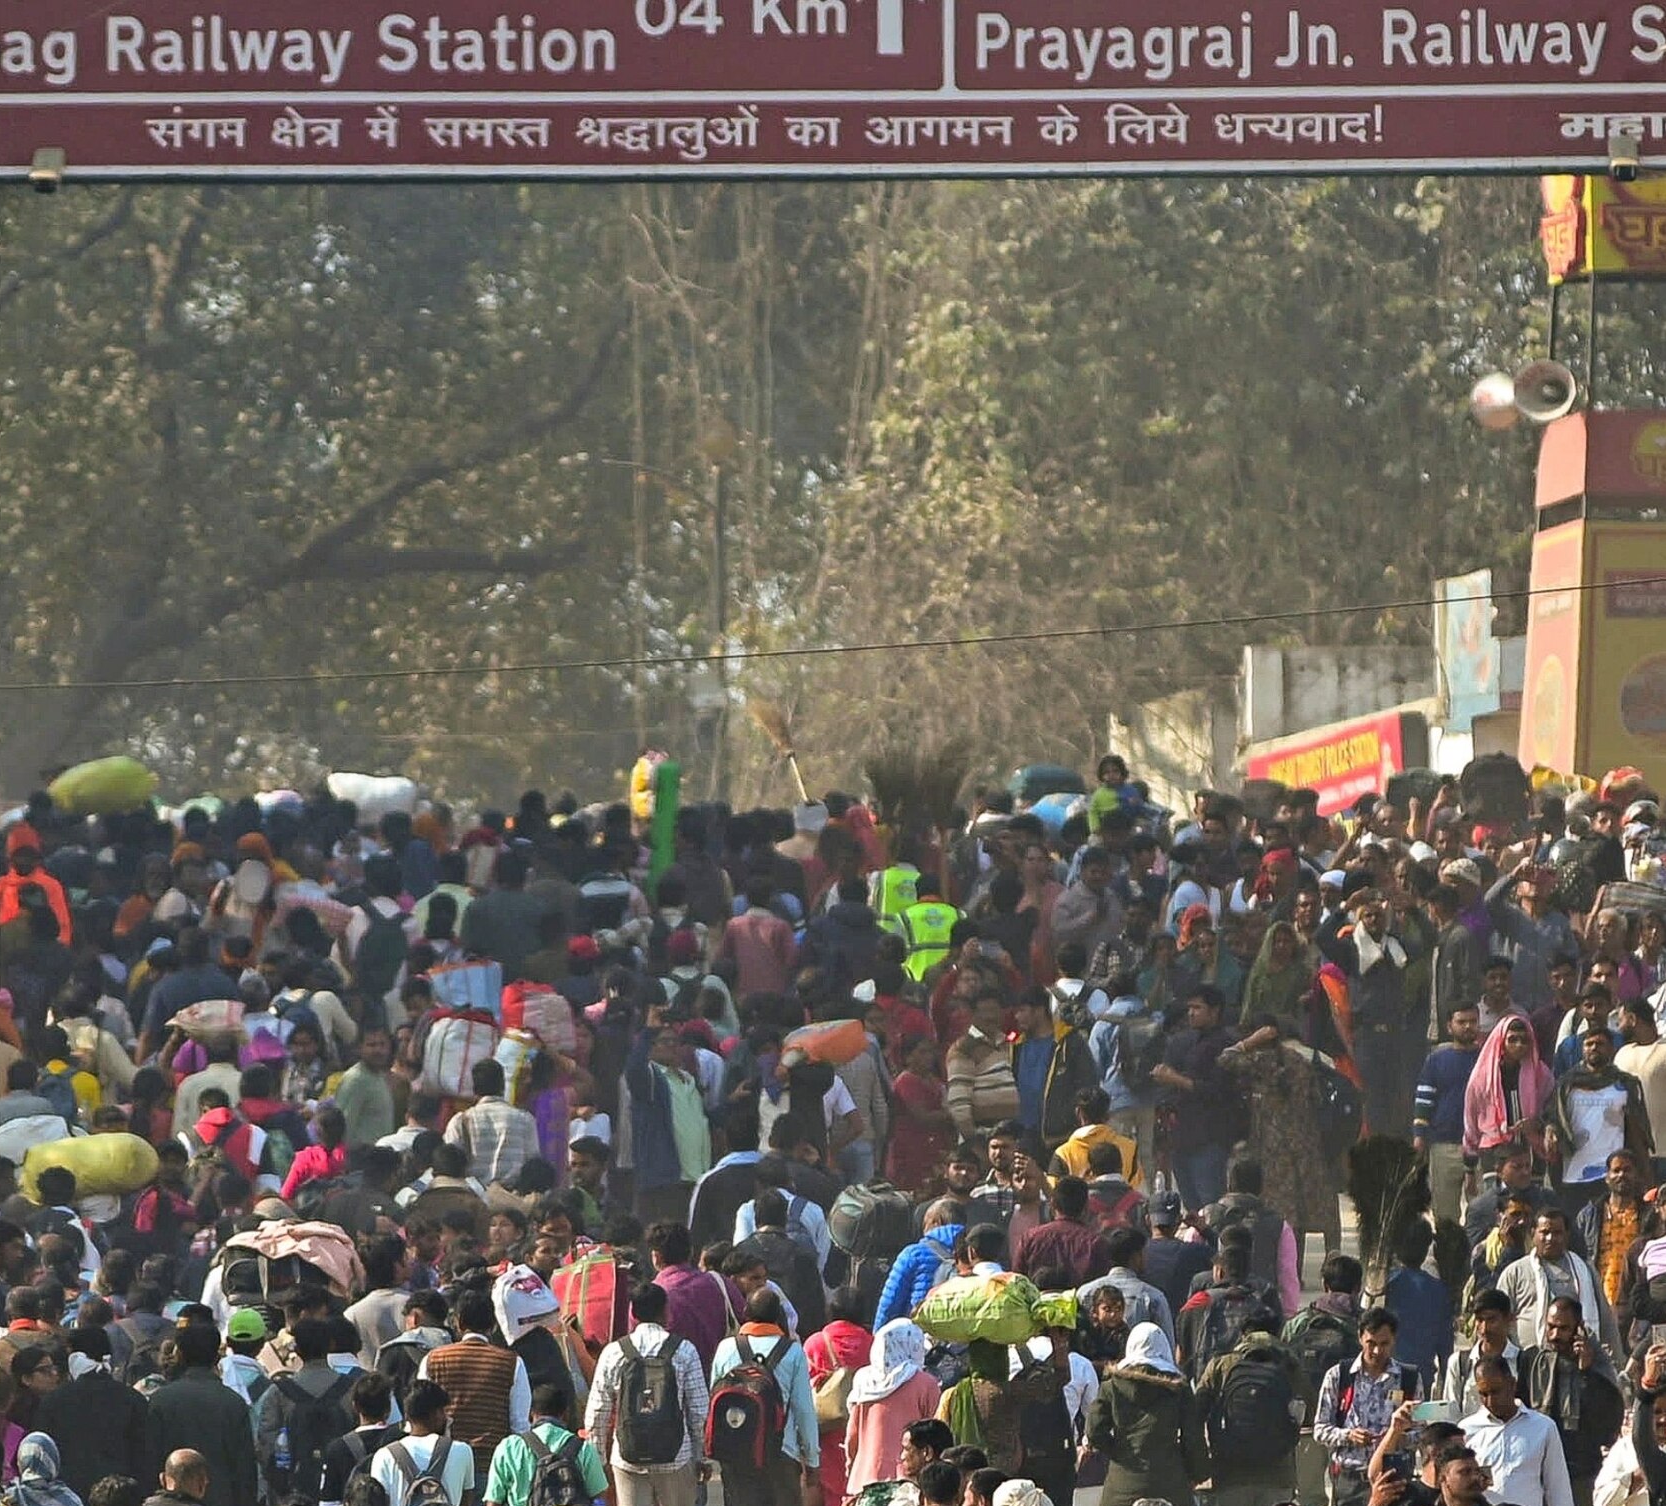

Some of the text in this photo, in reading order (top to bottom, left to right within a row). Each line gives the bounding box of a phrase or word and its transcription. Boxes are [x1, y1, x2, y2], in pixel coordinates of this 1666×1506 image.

[106, 15, 351, 83] Railway
[378, 13, 617, 72] Station
[636, 0, 848, 36] 04 Km
[976, 11, 1252, 80] Prayagraj
[1274, 10, 1354, 68] Jn.
[1382, 8, 1606, 76] Railway
[146, 103, 1384, 160] संगम क्षेत्र में समस्त श्रद्धालुओं का आगमन के लिये धन्यवाद!
